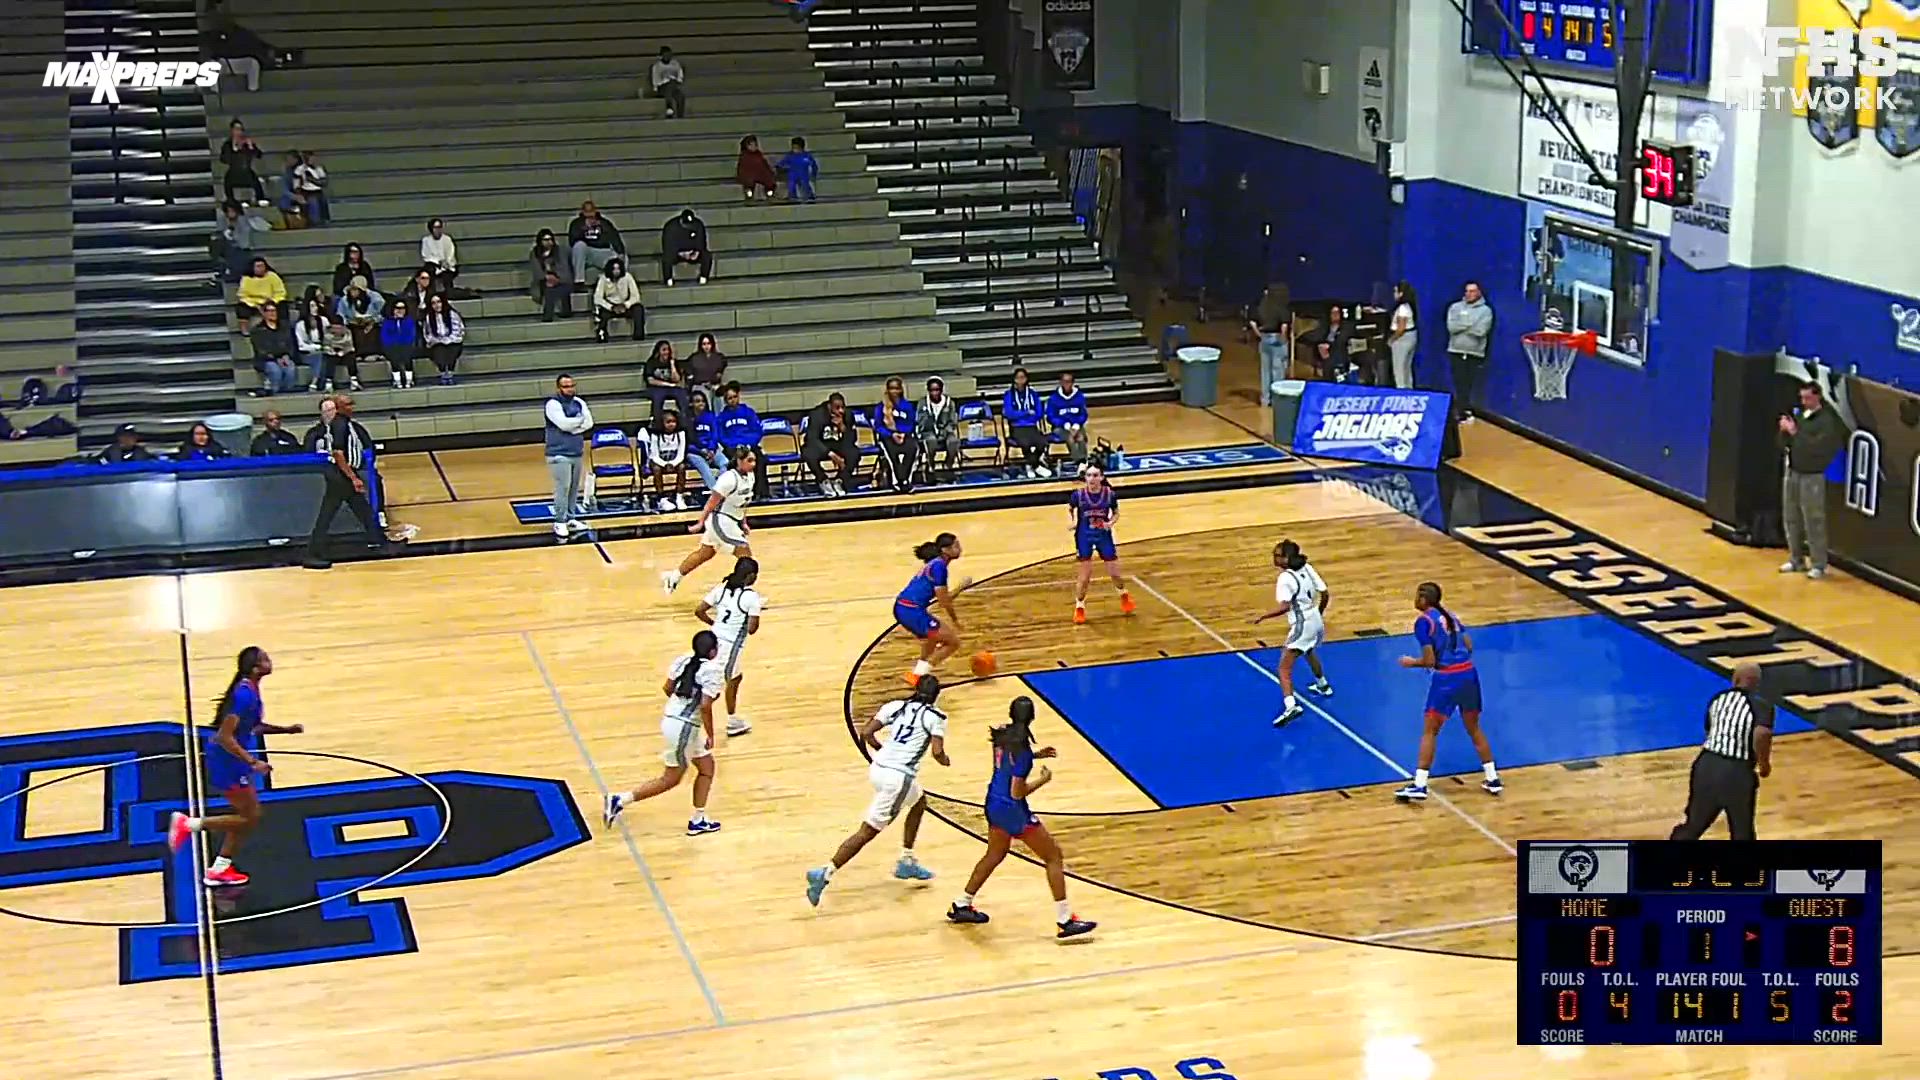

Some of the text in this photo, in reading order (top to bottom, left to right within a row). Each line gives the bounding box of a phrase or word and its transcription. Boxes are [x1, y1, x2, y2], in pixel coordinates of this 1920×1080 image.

[1643, 148, 1675, 198] 34
[1538, 176, 1614, 209] CHAMPIONSHI
[1673, 209, 1730, 234] CHAMPIONS
[1322, 396, 1429, 413] DESERT PINES
[1312, 413, 1424, 440] JAGUARS
[1453, 519, 1853, 670] DESERT
[721, 609, 731, 624] 2
[893, 724, 914, 744] 12
